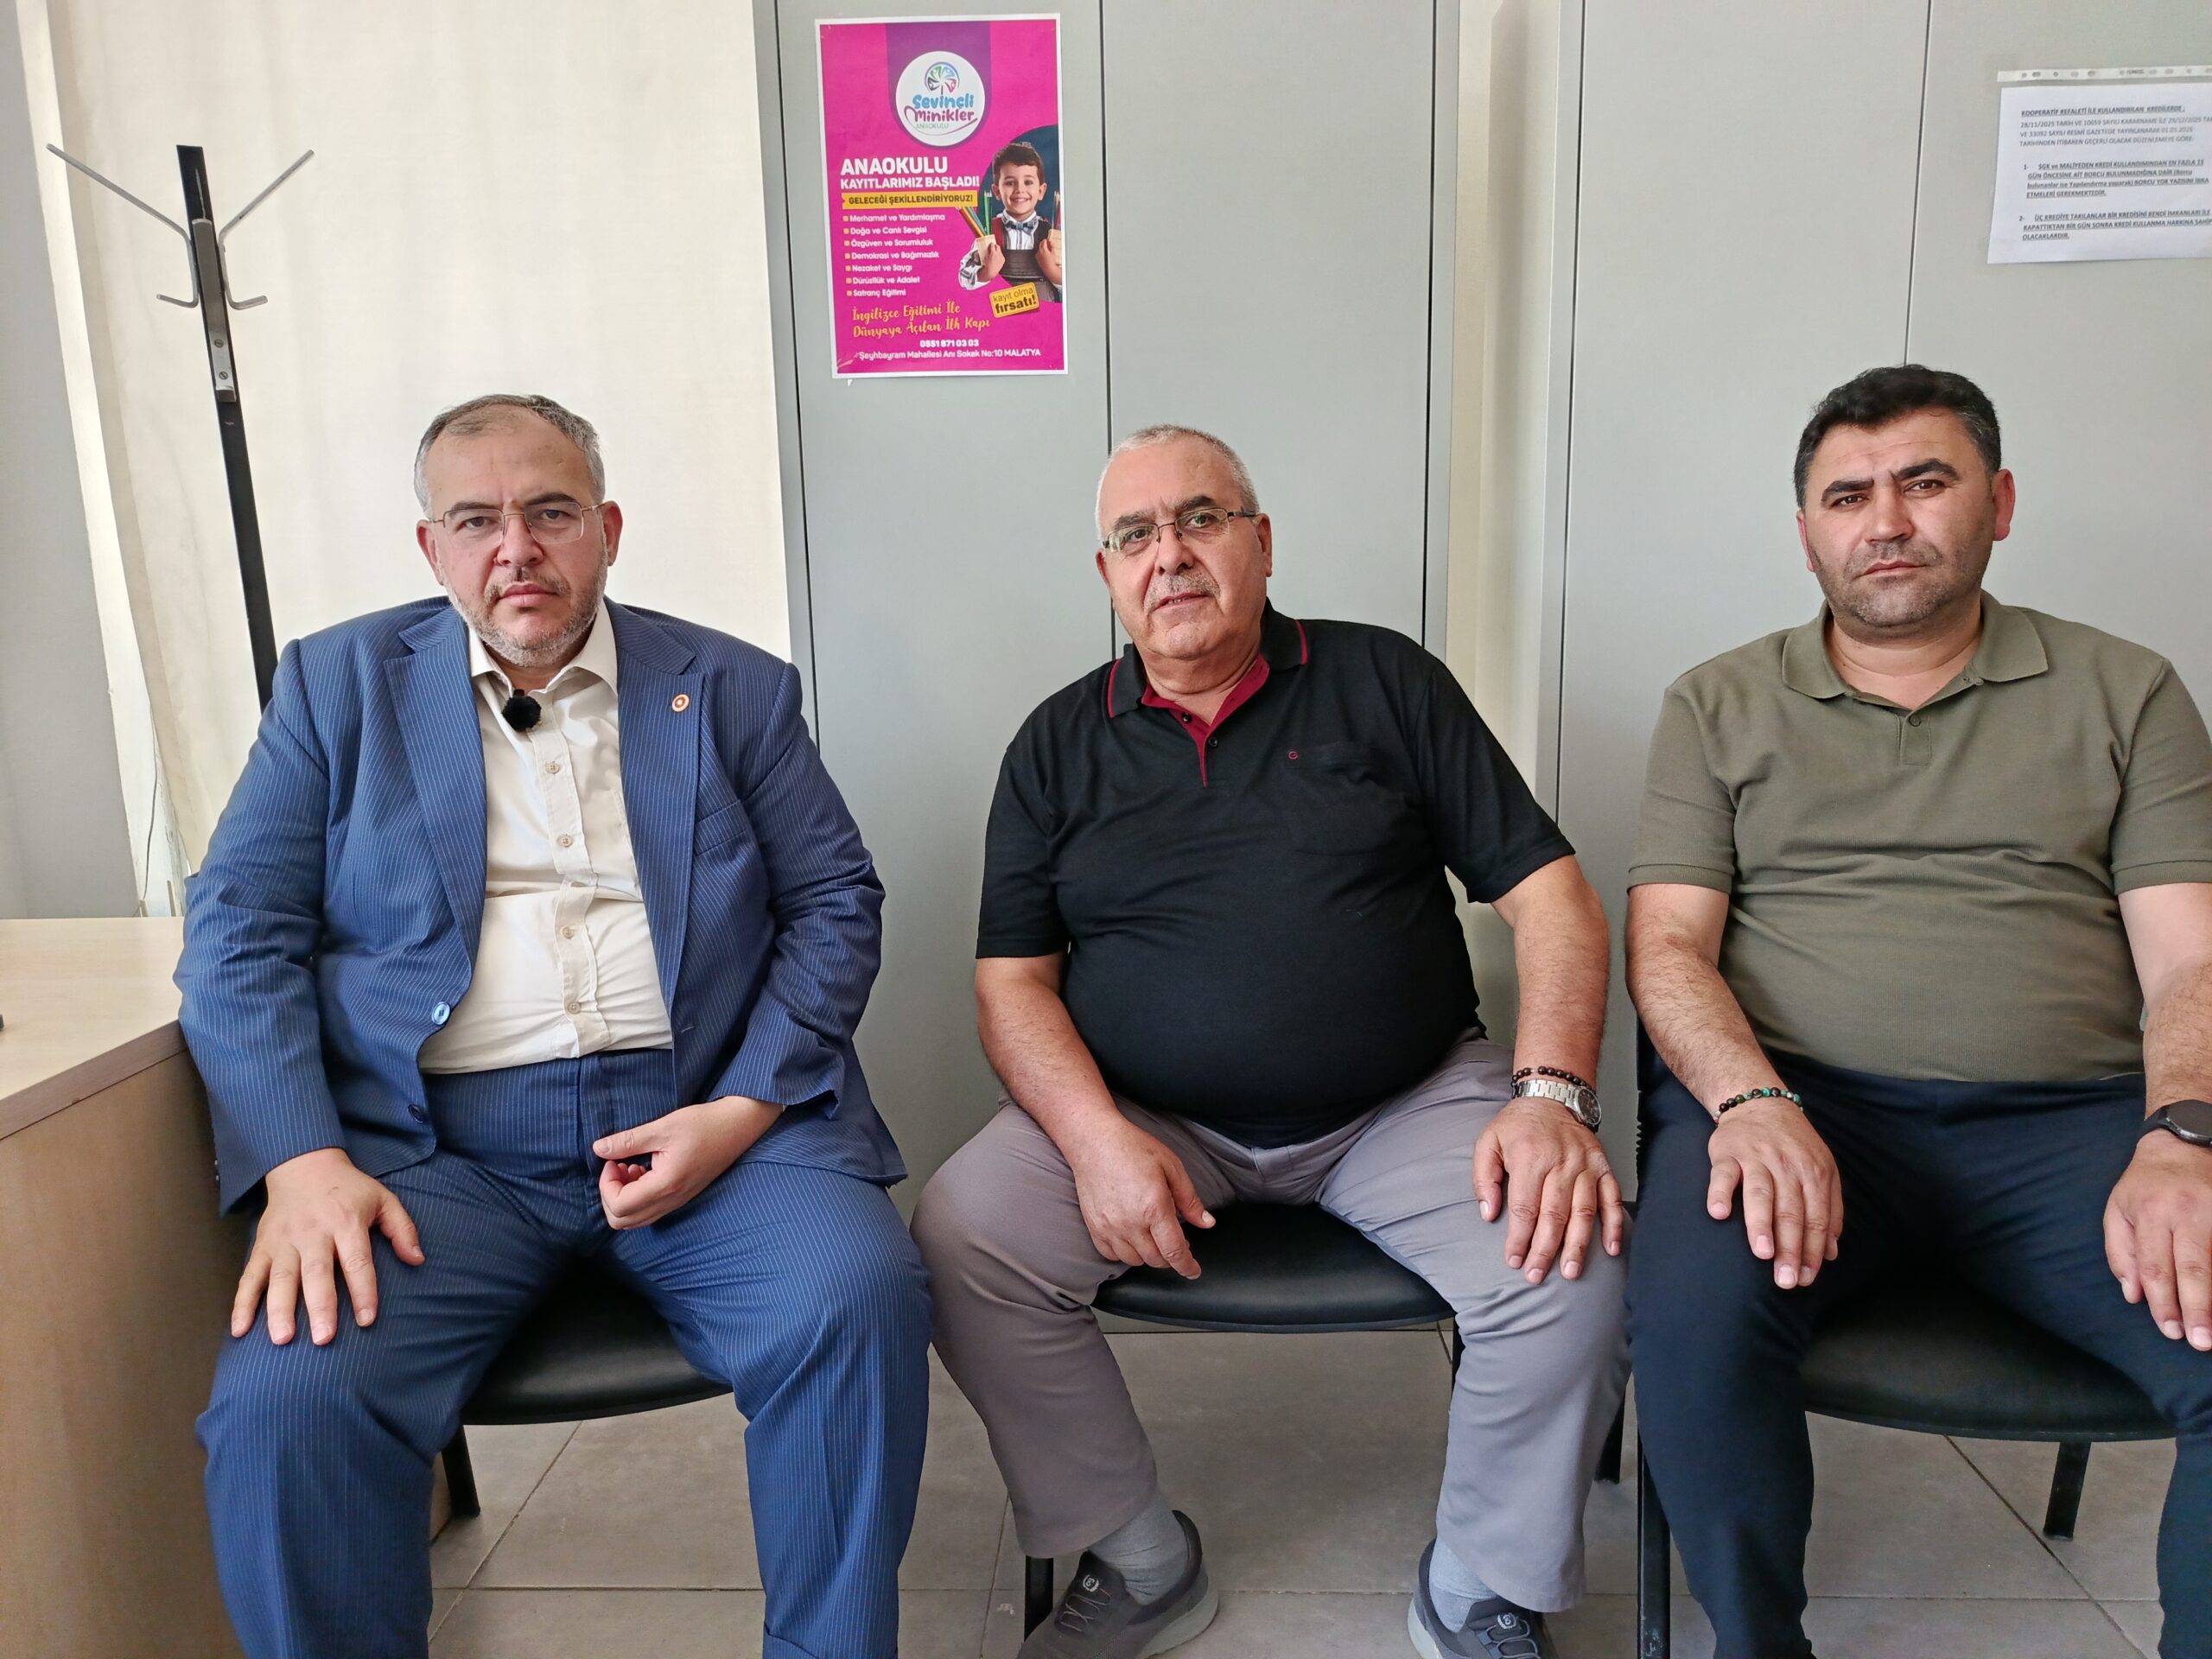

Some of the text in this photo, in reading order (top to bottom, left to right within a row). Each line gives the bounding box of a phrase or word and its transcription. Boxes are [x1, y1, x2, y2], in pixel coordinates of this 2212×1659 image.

[912, 93, 974, 109] Sevinçli
[914, 109, 975, 122] Minikler
[2022, 108, 2058, 117] KOOPERATİF
[840, 156, 948, 175] ANAOKULU
[841, 176, 980, 190] KAYITLARIMIZ BAŞLADI!
[849, 194, 973, 206] GELECEĞİ ŞEKİLLENDİRİYORUZ!
[2044, 213, 2069, 221] KREDİYE
[850, 227, 870, 236] Doğa
[903, 226, 927, 235] Sevgisi
[851, 238, 882, 248] Özgüven
[882, 289, 906, 297] Eğitimi
[993, 288, 1033, 303] kayıt olma
[995, 295, 1037, 314] fırsatı!
[852, 298, 961, 325] İngilizce Eğitimi İle
[853, 316, 991, 339] Dünyaya Açılan İlk Kapı
[919, 340, 941, 348] 0551
[941, 340, 956, 348] 871
[968, 339, 979, 347] 03
[859, 351, 906, 361] Şeyhbayram
[907, 350, 942, 359] Mahallesi
[957, 349, 980, 358] Sokak
[982, 349, 1002, 358] No:10
[1004, 348, 1041, 357] MALATYA
